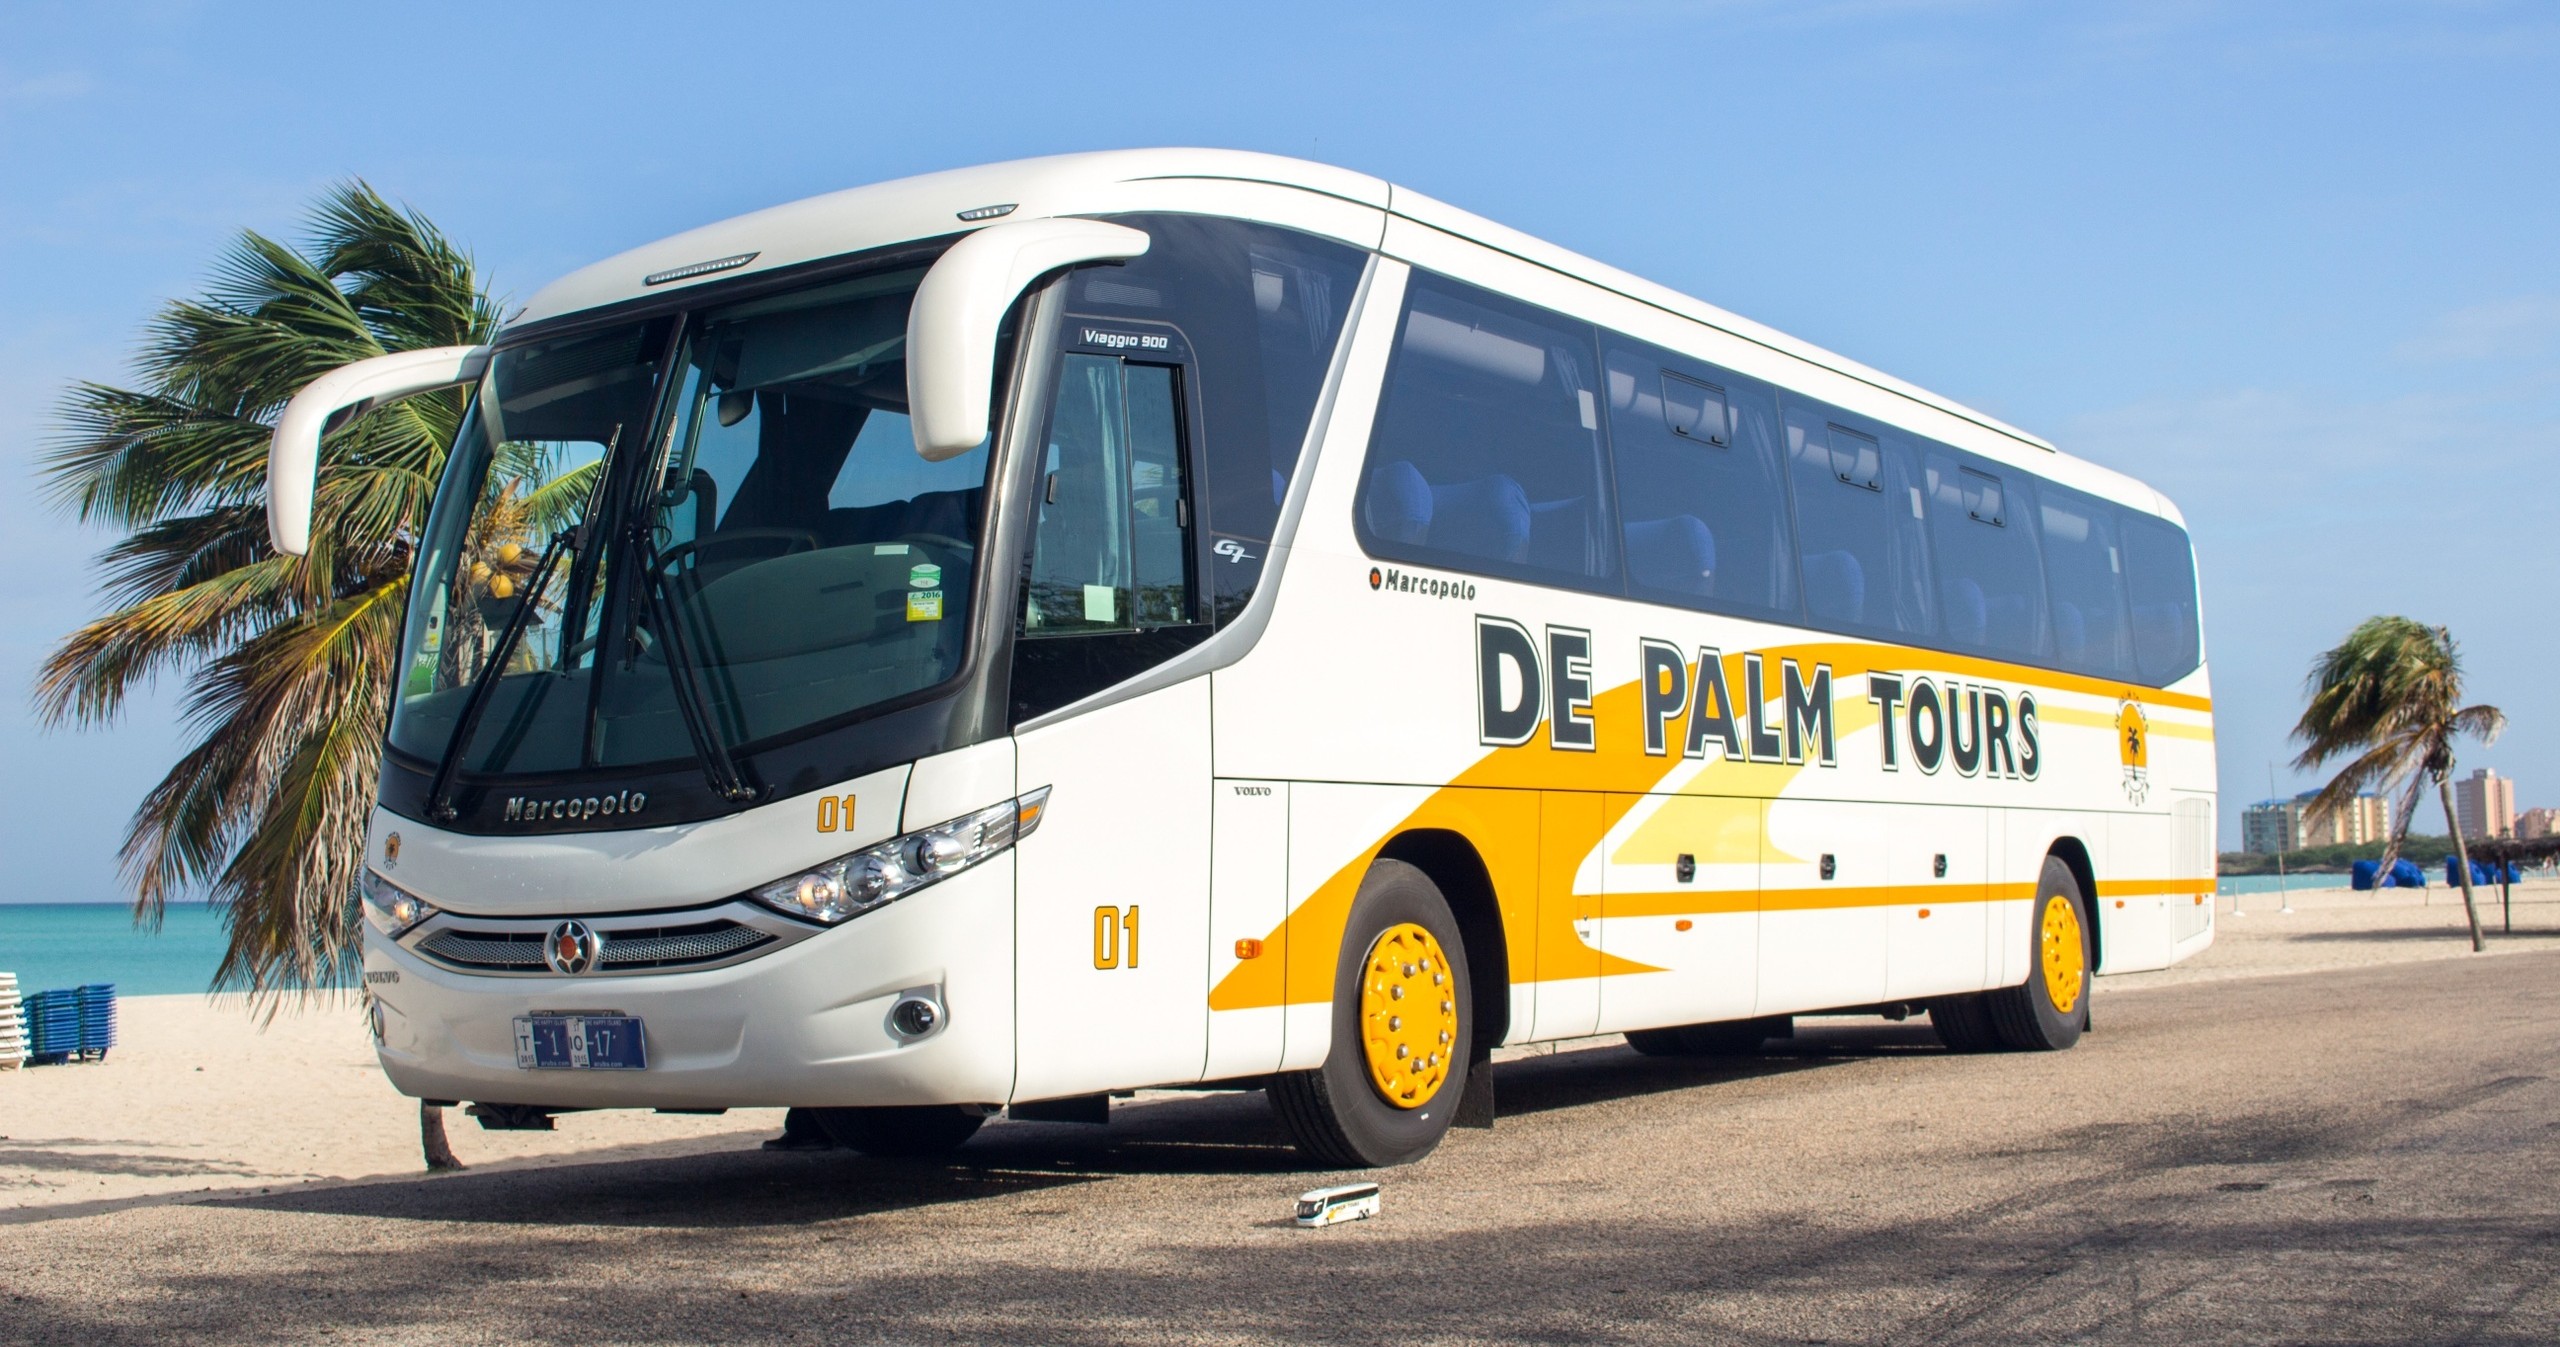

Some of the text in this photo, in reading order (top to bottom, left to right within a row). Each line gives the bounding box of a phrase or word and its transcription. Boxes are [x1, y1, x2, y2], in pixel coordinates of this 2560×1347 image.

[1084, 329, 1168, 348] Viaggio 900
[1385, 568, 1476, 601] Marcopolo
[1475, 613, 2041, 782] DE PALM TOURS
[504, 790, 645, 821] Marcopolo
[1234, 786, 1272, 796] VOLVO
[817, 794, 856, 833] 01
[1094, 905, 1139, 970] 01
[366, 970, 400, 984] VOLVO
[593, 1060, 623, 1068] aruba.com
